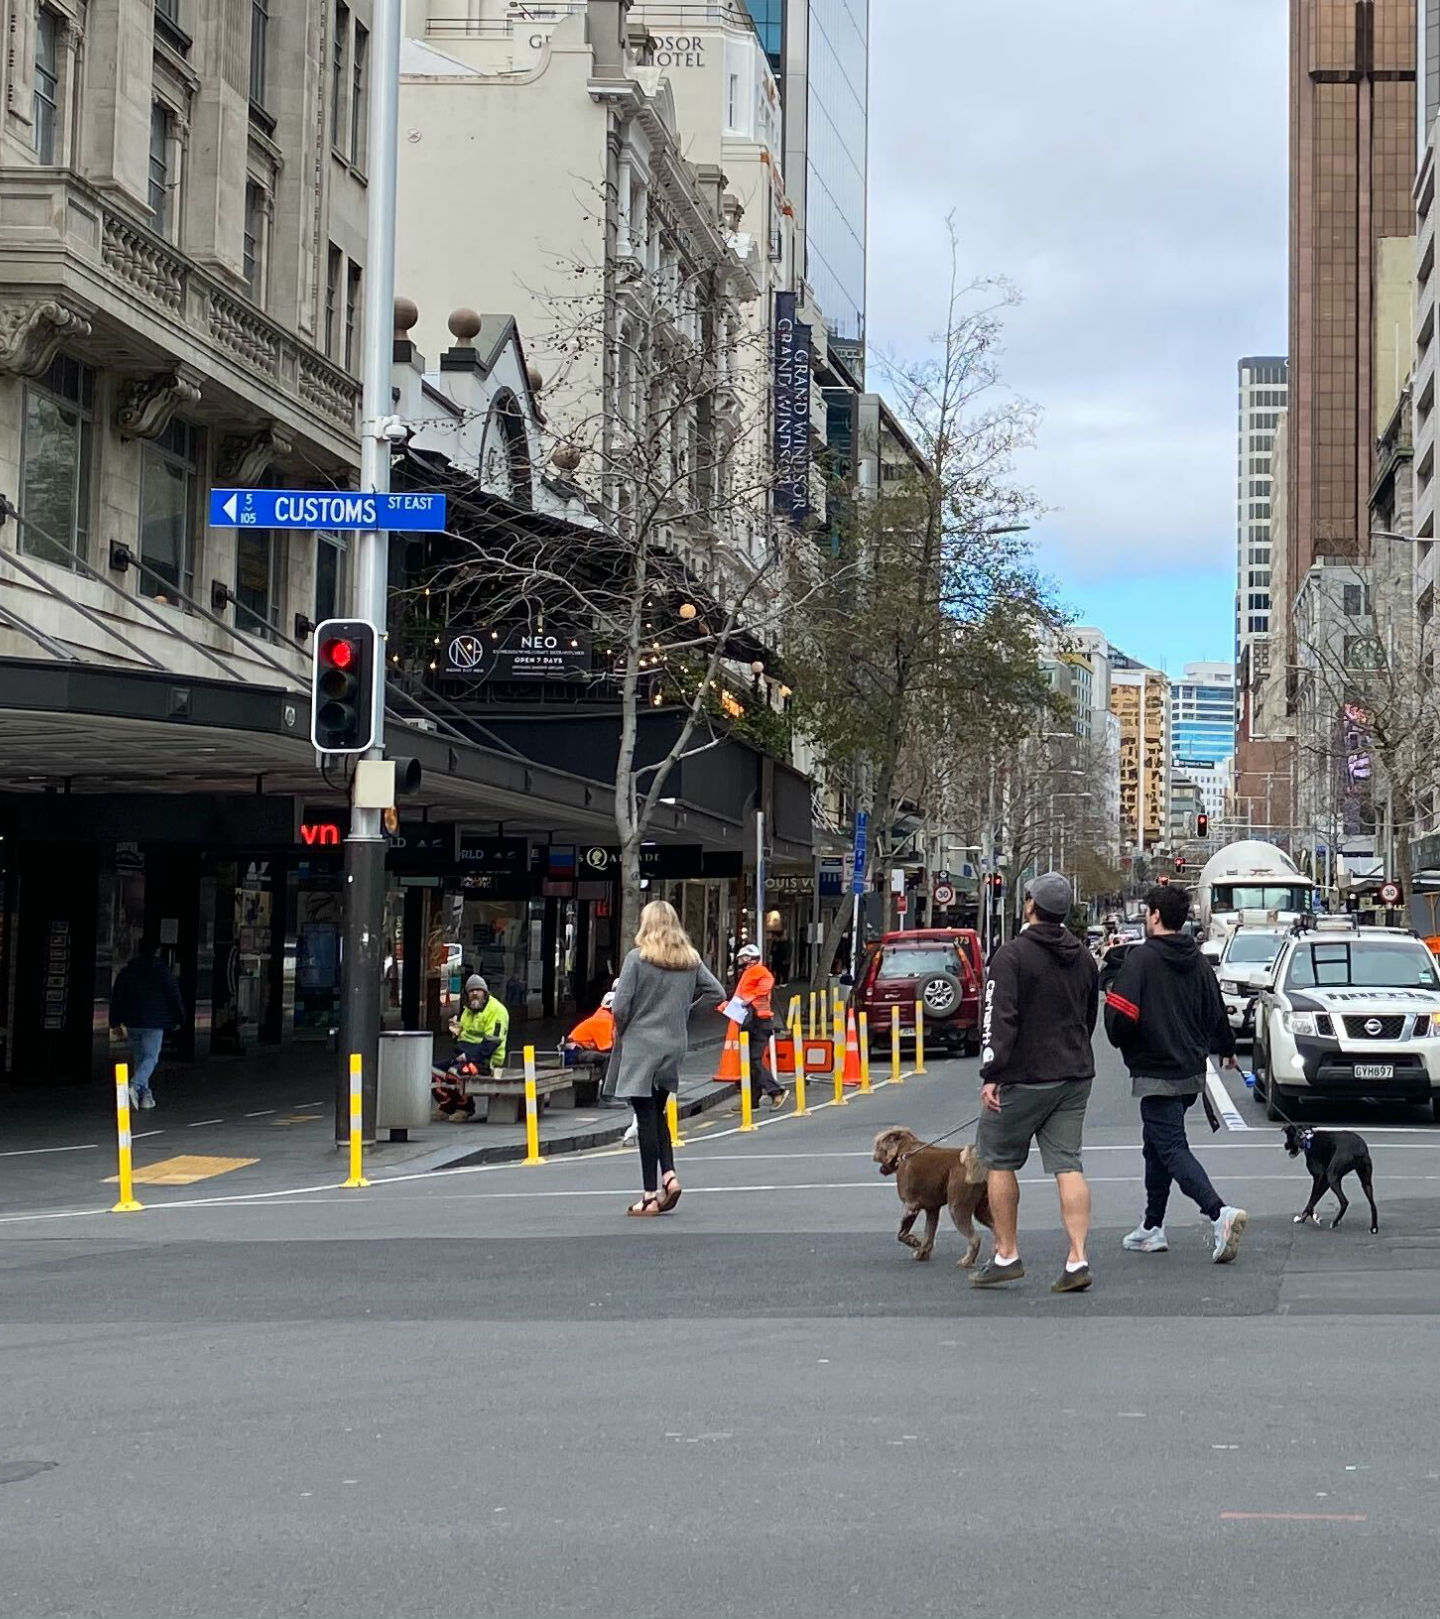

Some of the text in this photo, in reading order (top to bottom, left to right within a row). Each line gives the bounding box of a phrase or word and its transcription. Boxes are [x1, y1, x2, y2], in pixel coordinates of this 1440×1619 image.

[793, 350, 809, 416] GRAND
[245, 493, 253, 505] 5
[274, 496, 433, 523] CUSTOMS ST EAST
[240, 512, 257, 525] 105
[520, 636, 558, 649] NEO
[937, 889, 949, 899] 30
[1384, 888, 1397, 897] 30
[1355, 1066, 1393, 1077] GYH897
